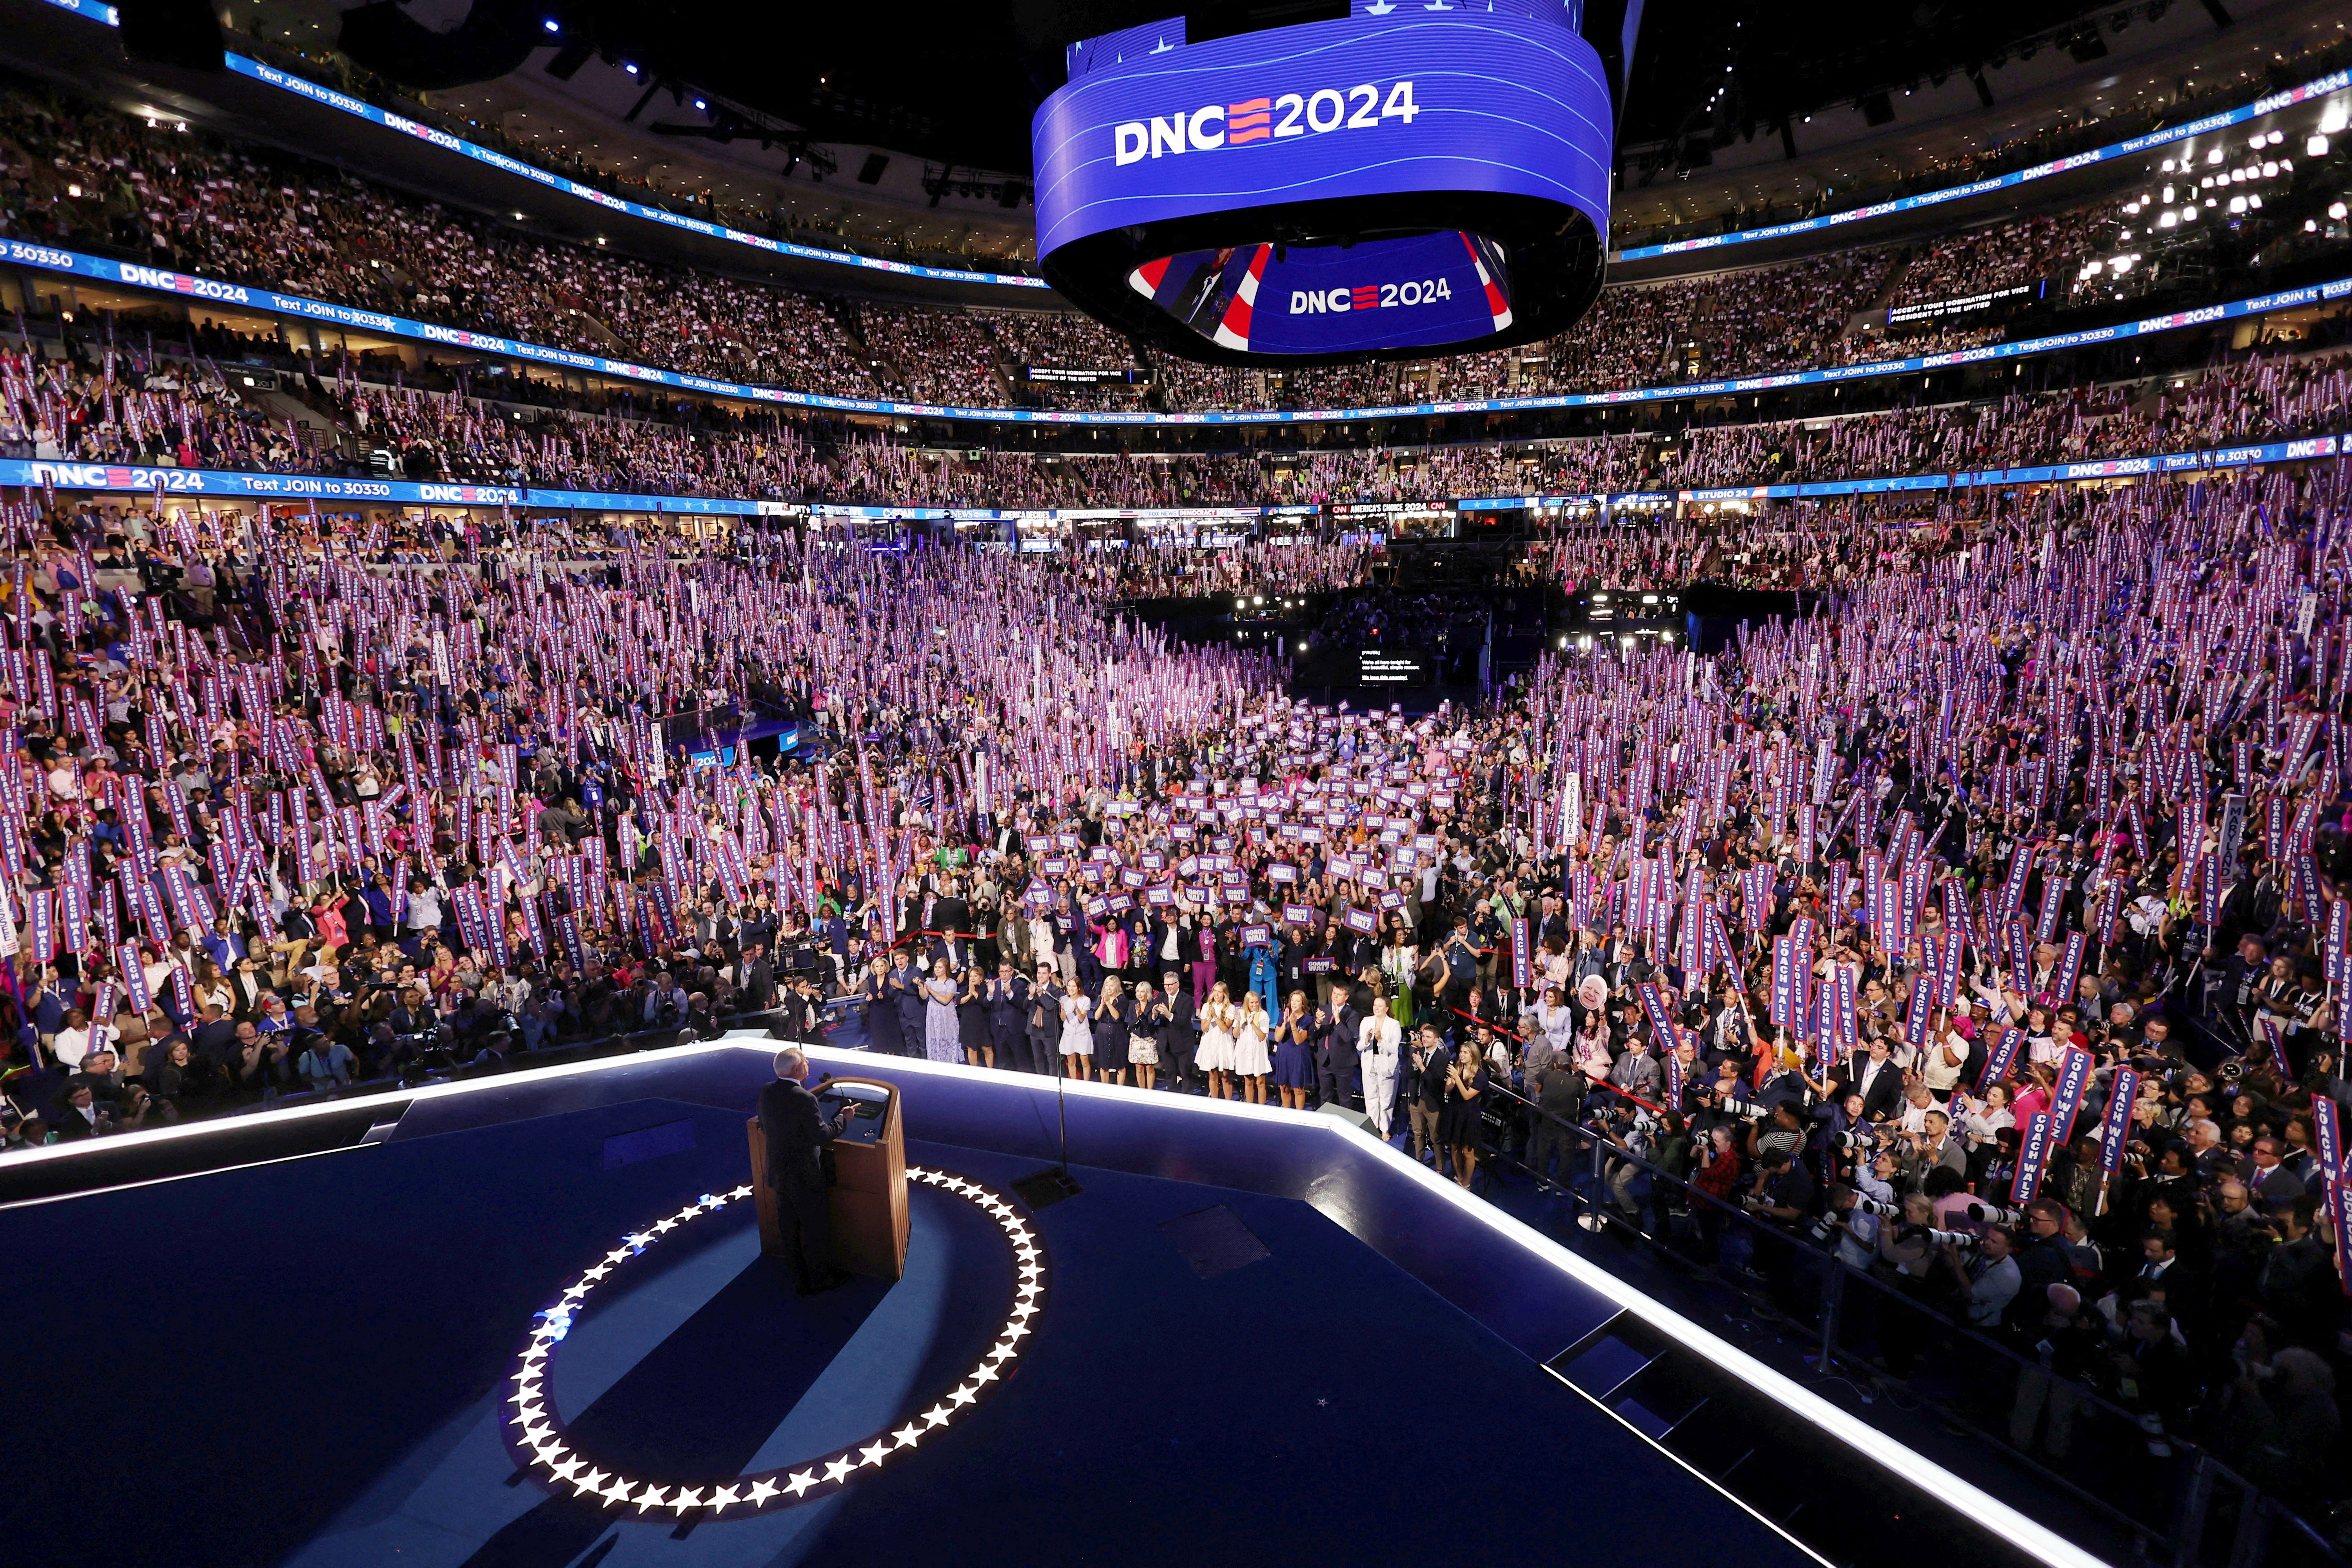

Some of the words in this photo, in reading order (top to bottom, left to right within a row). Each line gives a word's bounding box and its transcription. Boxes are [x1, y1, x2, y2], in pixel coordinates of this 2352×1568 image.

[257, 66, 282, 83] Text
[285, 78, 313, 94] JOIN
[316, 89, 327, 99] to
[329, 93, 363, 113] 30330
[2305, 74, 2348, 101] 2024
[1274, 82, 1419, 137] 2024
[428, 130, 461, 150] 2024
[830, 253, 850, 261] 30330
[194, 280, 249, 302] 2024
[1381, 278, 1451, 307] 2024
[1892, 305, 1921, 315] ACCEPT
[1924, 302, 1944, 310] YOUR
[1946, 294, 1991, 307] NOMINATION
[1994, 290, 2009, 299] FOR
[2011, 286, 2029, 294] VICE
[1891, 311, 1933, 322] PRESIDENT
[2184, 307, 2224, 323] 2024
[470, 334, 505, 351] 2024
[1962, 347, 1995, 361] 2024
[1842, 368, 1864, 377] JOIN
[1875, 360, 1906, 372] 30330
[131, 470, 205, 491] 2024
[242, 477, 278, 490] Text
[283, 480, 321, 492] JOIN
[325, 483, 340, 493] to
[343, 483, 389, 495] 30330
[1698, 490, 1734, 499] STUDIO
[825, 507, 845, 515] NEWS
[1350, 505, 1381, 513] AMERICA'S
[1383, 503, 1403, 512] CHOICE
[1405, 503, 1427, 511] 2024
[436, 638, 447, 677] VIRGINIA
[654, 730, 664, 771] OKLAHOMA
[697, 755, 717, 766] 202
[1820, 748, 1829, 795] ILLINOIS
[1568, 782, 1576, 835] CALIFORNIA
[2221, 807, 2241, 876] MARYLAND
[36, 893, 46, 927] COACH
[2330, 901, 2341, 942] COACH
[36, 929, 48, 958] WALZ
[1246, 934, 1266, 943] WALZ
[1884, 921, 1893, 949] WALZ
[1517, 958, 1525, 984] WALZ
[1779, 940, 1789, 983] COACH
[2328, 945, 2339, 978] WALZ
[123, 946, 139, 980] COACH
[131, 982, 147, 1009] WALZ
[1643, 986, 1662, 1018] COACH
[1656, 1021, 1674, 1047] WALZ
[1777, 986, 1789, 1022] WALZ
[2112, 1072, 2131, 1123] COACH
[2028, 1114, 2046, 1160] COACH
[2105, 1125, 2122, 1167] WALZ
[2020, 1163, 2037, 1200] WALZ
